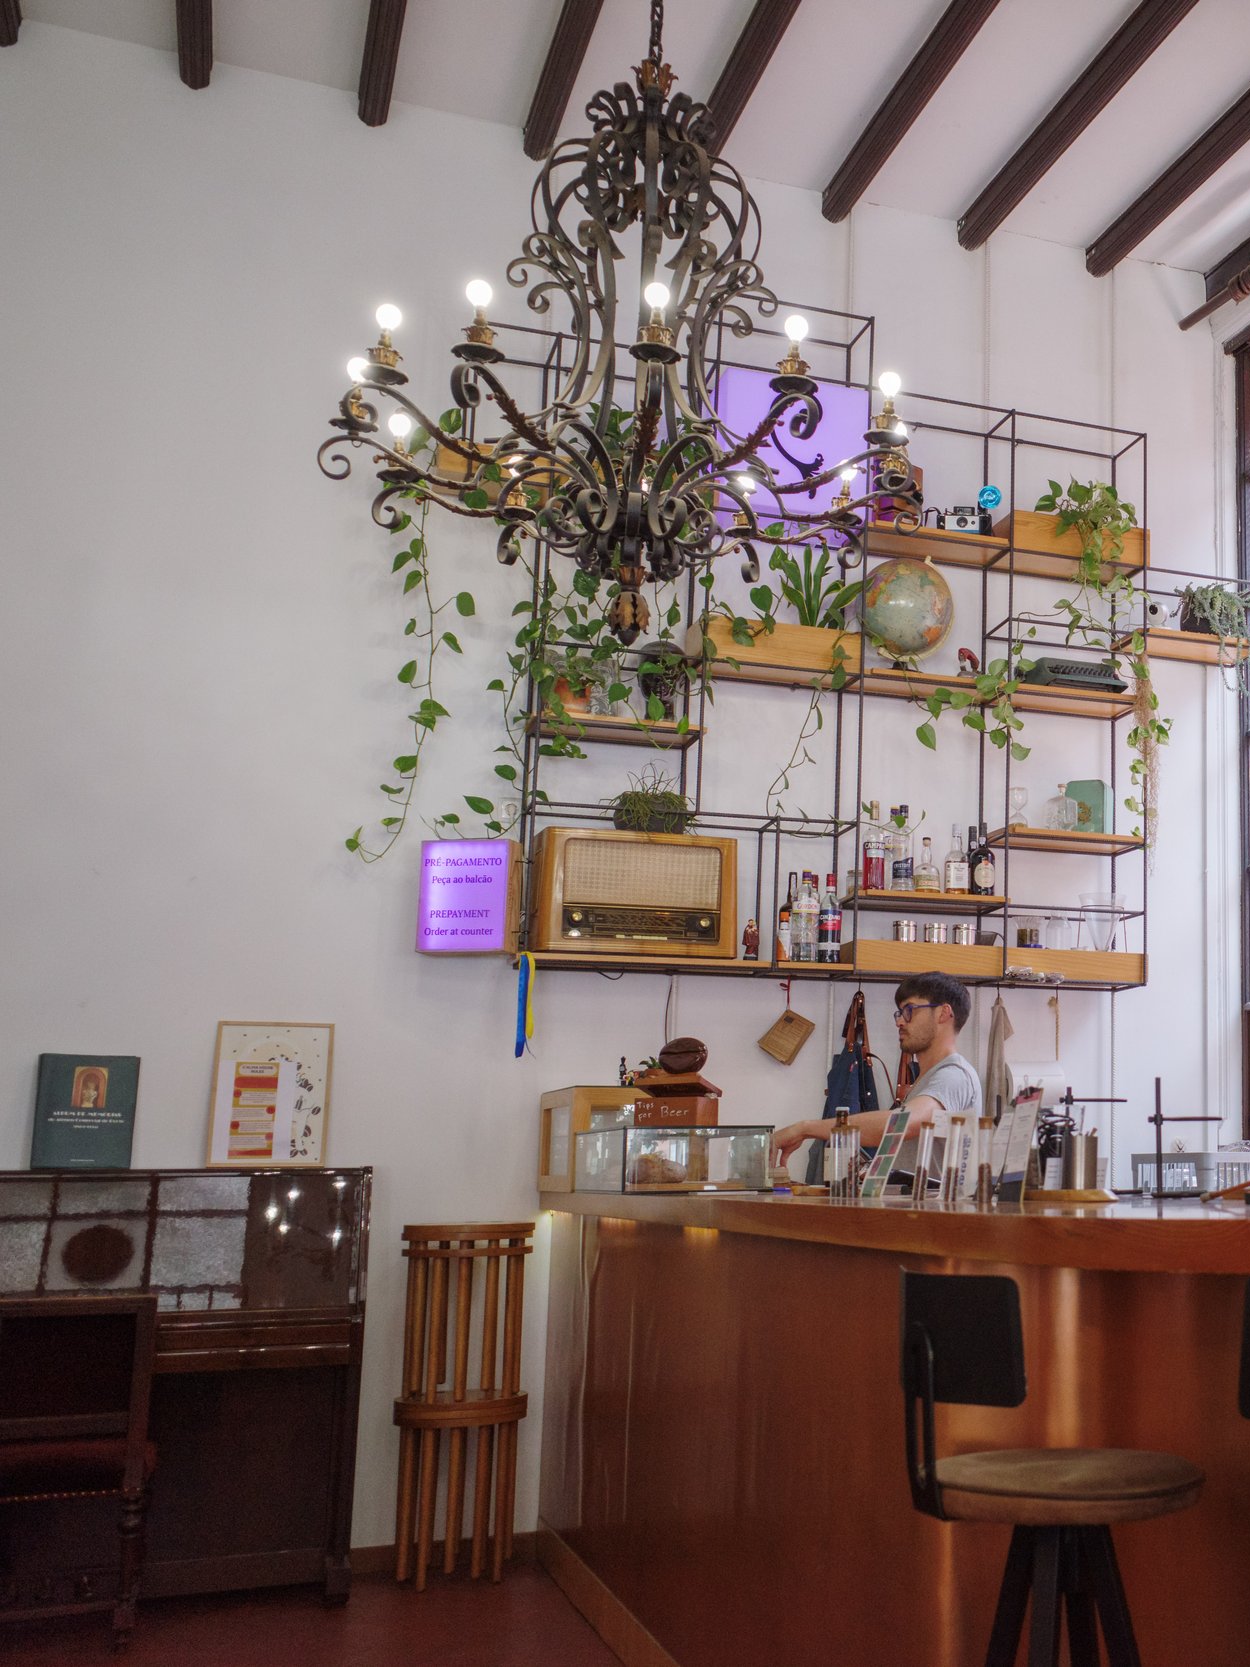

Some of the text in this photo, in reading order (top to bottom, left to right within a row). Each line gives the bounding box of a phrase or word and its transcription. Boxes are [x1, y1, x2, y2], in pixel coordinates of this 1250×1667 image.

[424, 857, 503, 867] PRÉ-PAGAMENTO
[432, 876, 451, 886] Peça
[465, 875, 493, 883] balcão
[430, 909, 490, 918] PREPAYMENT
[424, 927, 448, 935] Order
[636, 1101, 689, 1118] Tips Beer
[638, 1112, 652, 1122] for
